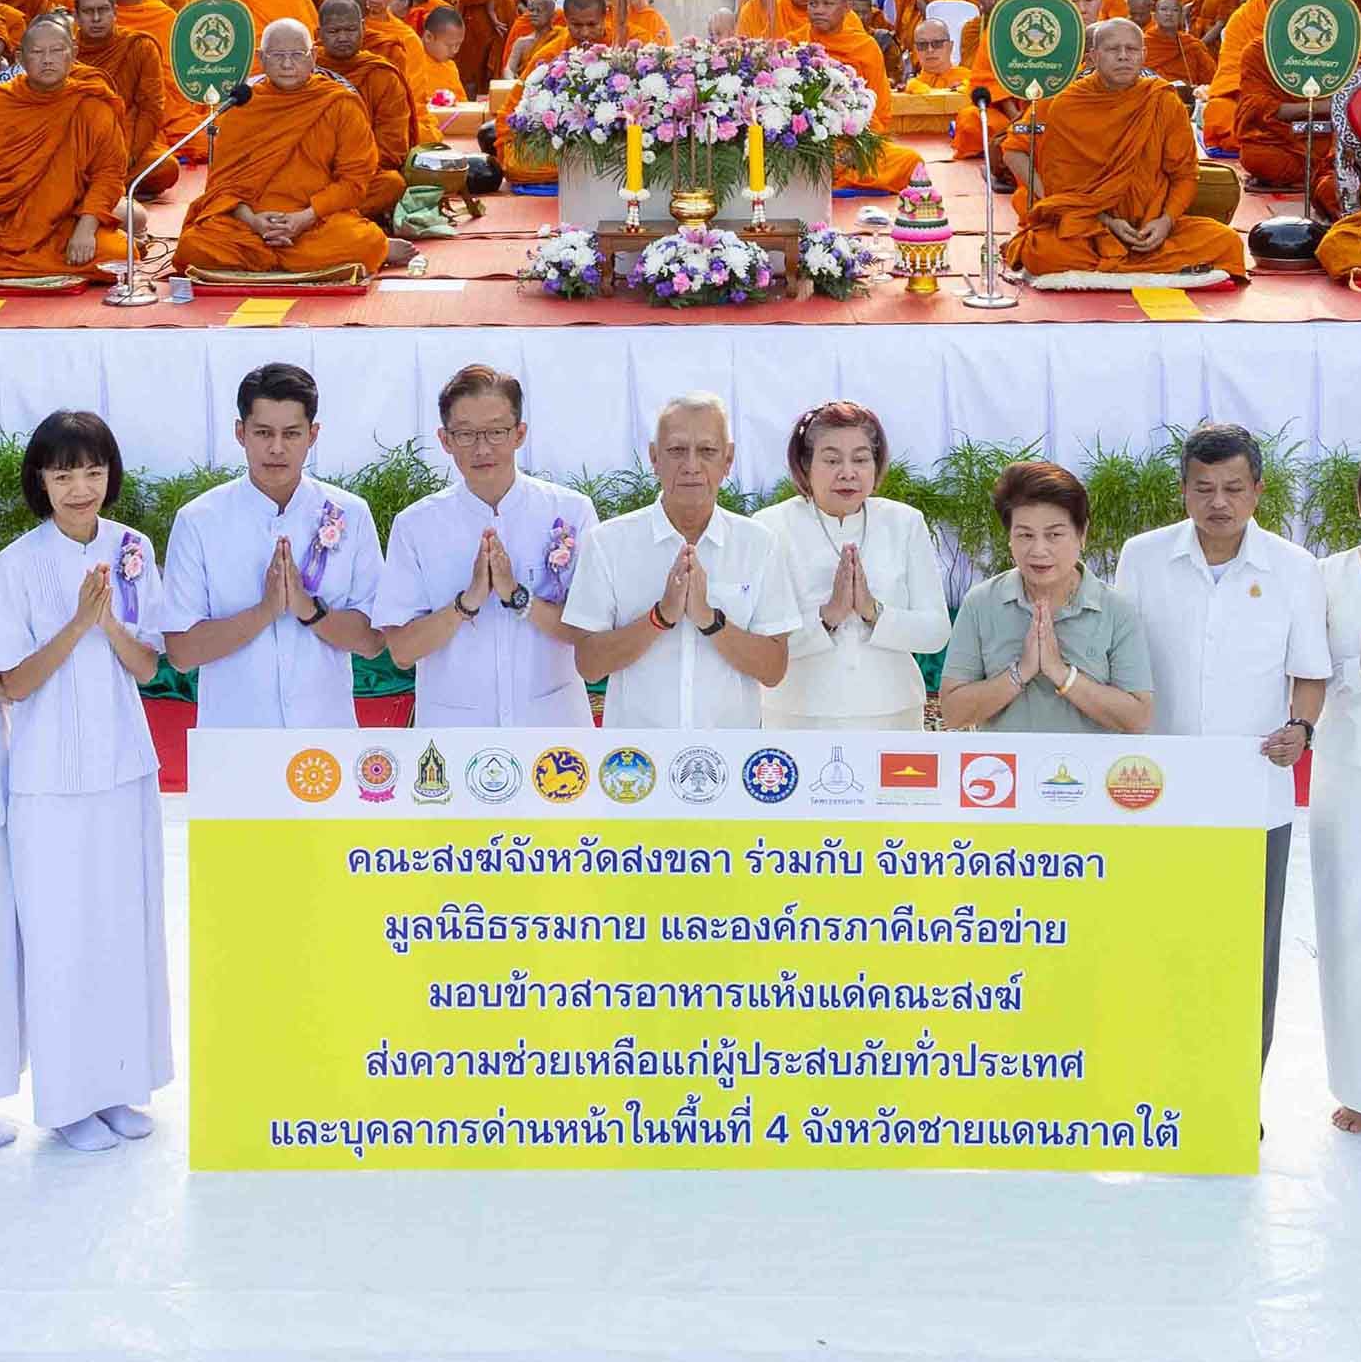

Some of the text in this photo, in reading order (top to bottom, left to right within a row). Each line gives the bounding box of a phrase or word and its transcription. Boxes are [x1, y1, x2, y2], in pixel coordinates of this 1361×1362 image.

[348, 835, 1104, 879] คณะสงฆ์จังหวัดสงขลา ร่วมกับ จังหวัดสงขลา
[385, 902, 1066, 954] มูลนิธิธรรมกาย และองค์กรภาคีเครือข่าย
[429, 968, 1023, 1011] มอบข้าวสารอาหารแห้งแด่คณะสงฆ์
[366, 1029, 1083, 1089] ส่งความช่วยเหลือแก่ผู้ประสบภัยทั่วประเทศ
[271, 1093, 1181, 1158] และบุคลากรด่านหน้าในพื้นที่ 4 จังหวัดชายแดนภาคใต้
